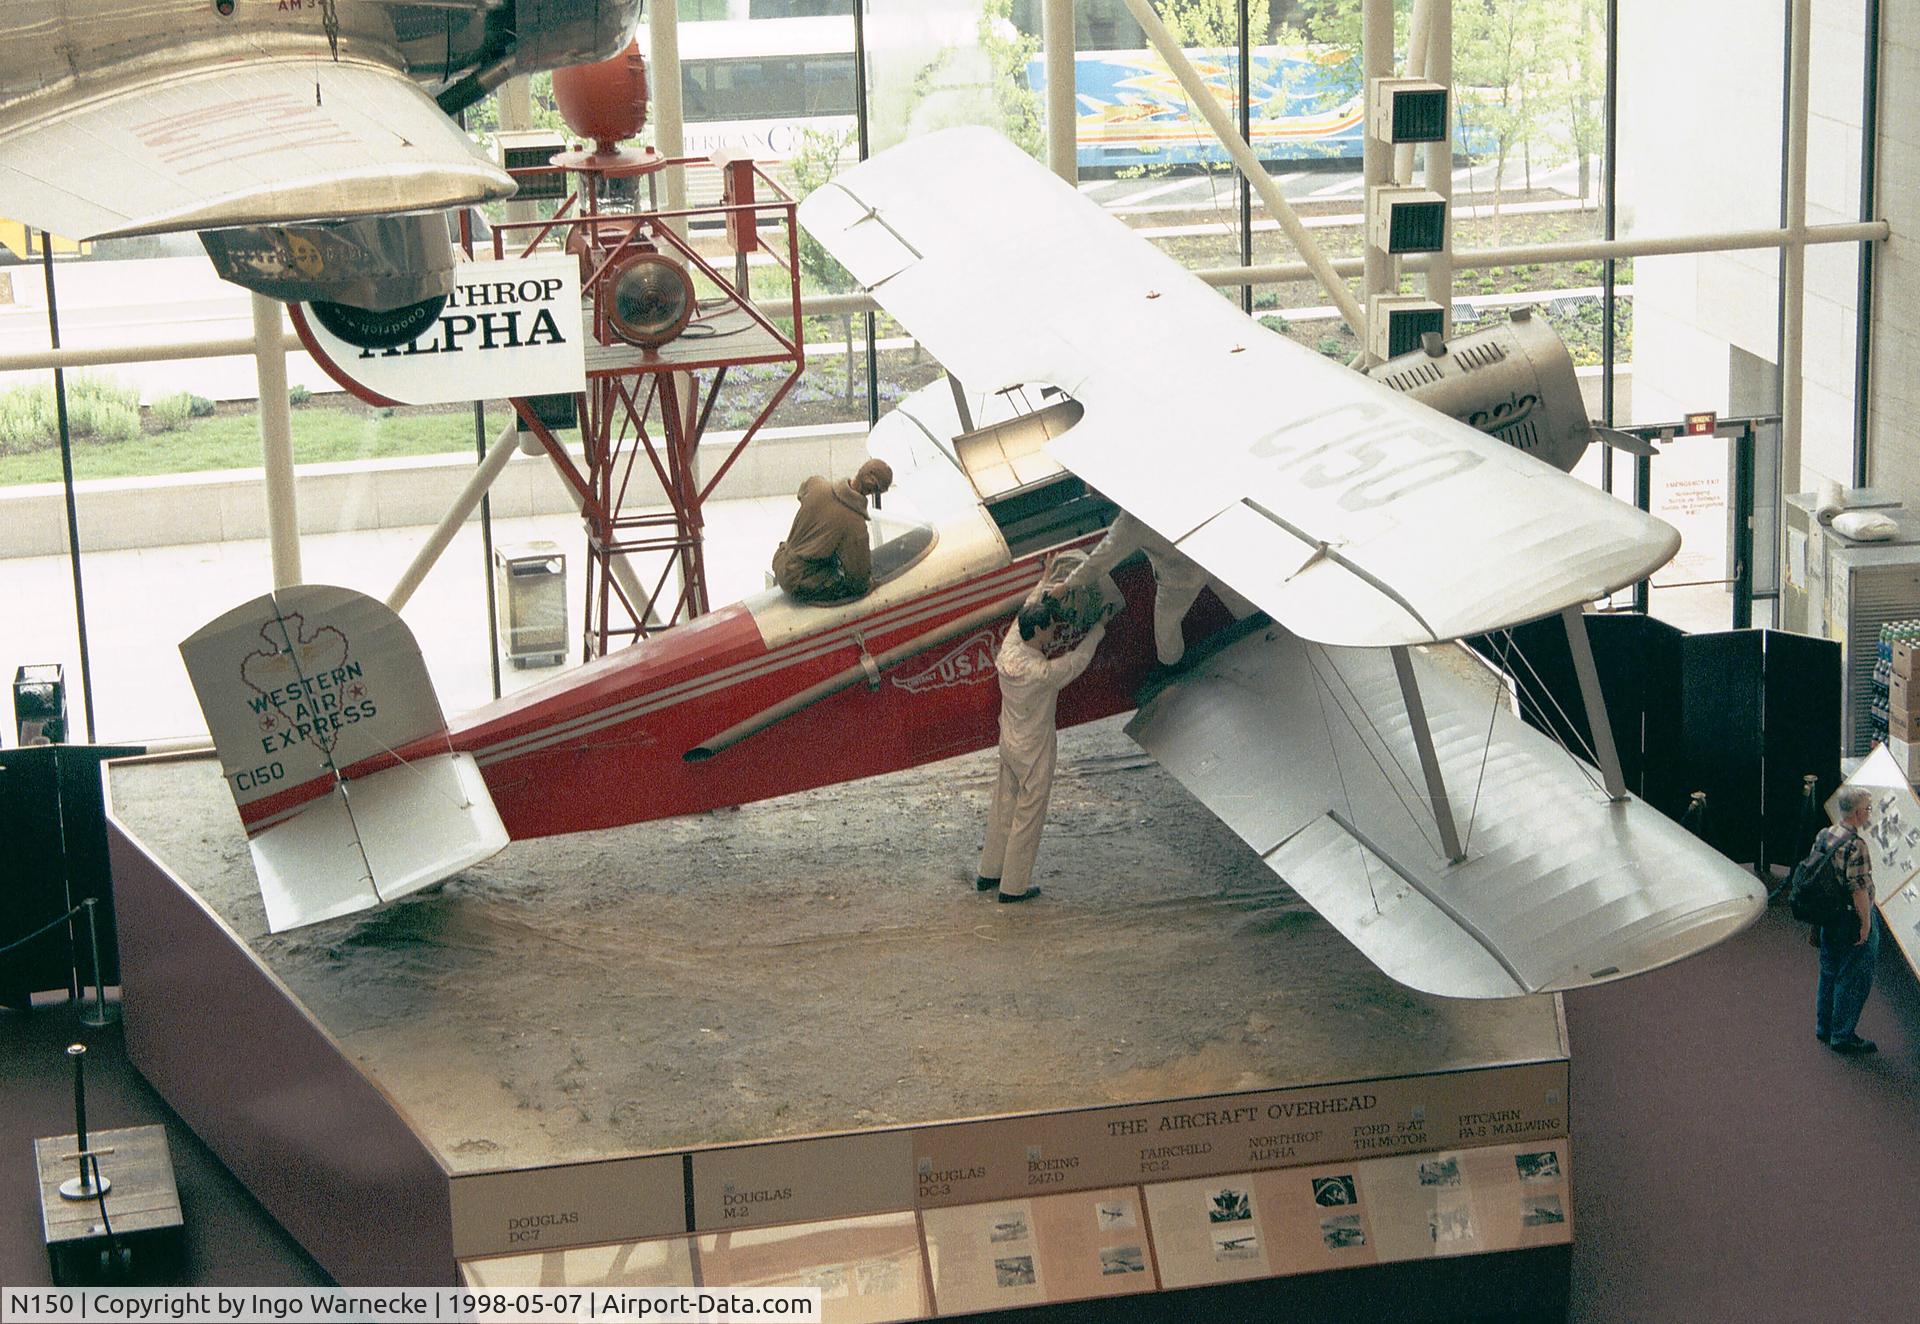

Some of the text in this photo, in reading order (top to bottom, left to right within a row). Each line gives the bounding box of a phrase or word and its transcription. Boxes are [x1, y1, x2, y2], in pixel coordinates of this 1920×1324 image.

[447, 278, 563, 308] THROP
[359, 308, 566, 359] LPHA
[247, 661, 363, 715] WESTERN
[296, 692, 338, 721] AIR
[261, 700, 377, 753] EXPRESS
[236, 762, 285, 791] C150
[1108, 1094, 1378, 1137] THE AIRCRAFT OVERHEAD
[1458, 1109, 1521, 1126] PITCAIRN
[1249, 1130, 1324, 1149] NORTHROP
[1353, 1123, 1391, 1137] FORD
[1140, 1142, 1213, 1160] FAIRCHILD
[1250, 1146, 1297, 1162] ALPHA
[1028, 1156, 1080, 1173] BOEING
[919, 1166, 986, 1184] DOUGLAS
[723, 1187, 792, 1206] DOUGLAS
[919, 1183, 951, 1198] DC-3
[508, 1211, 579, 1230] DOUGLAS
[509, 1229, 541, 1243] DC-7
